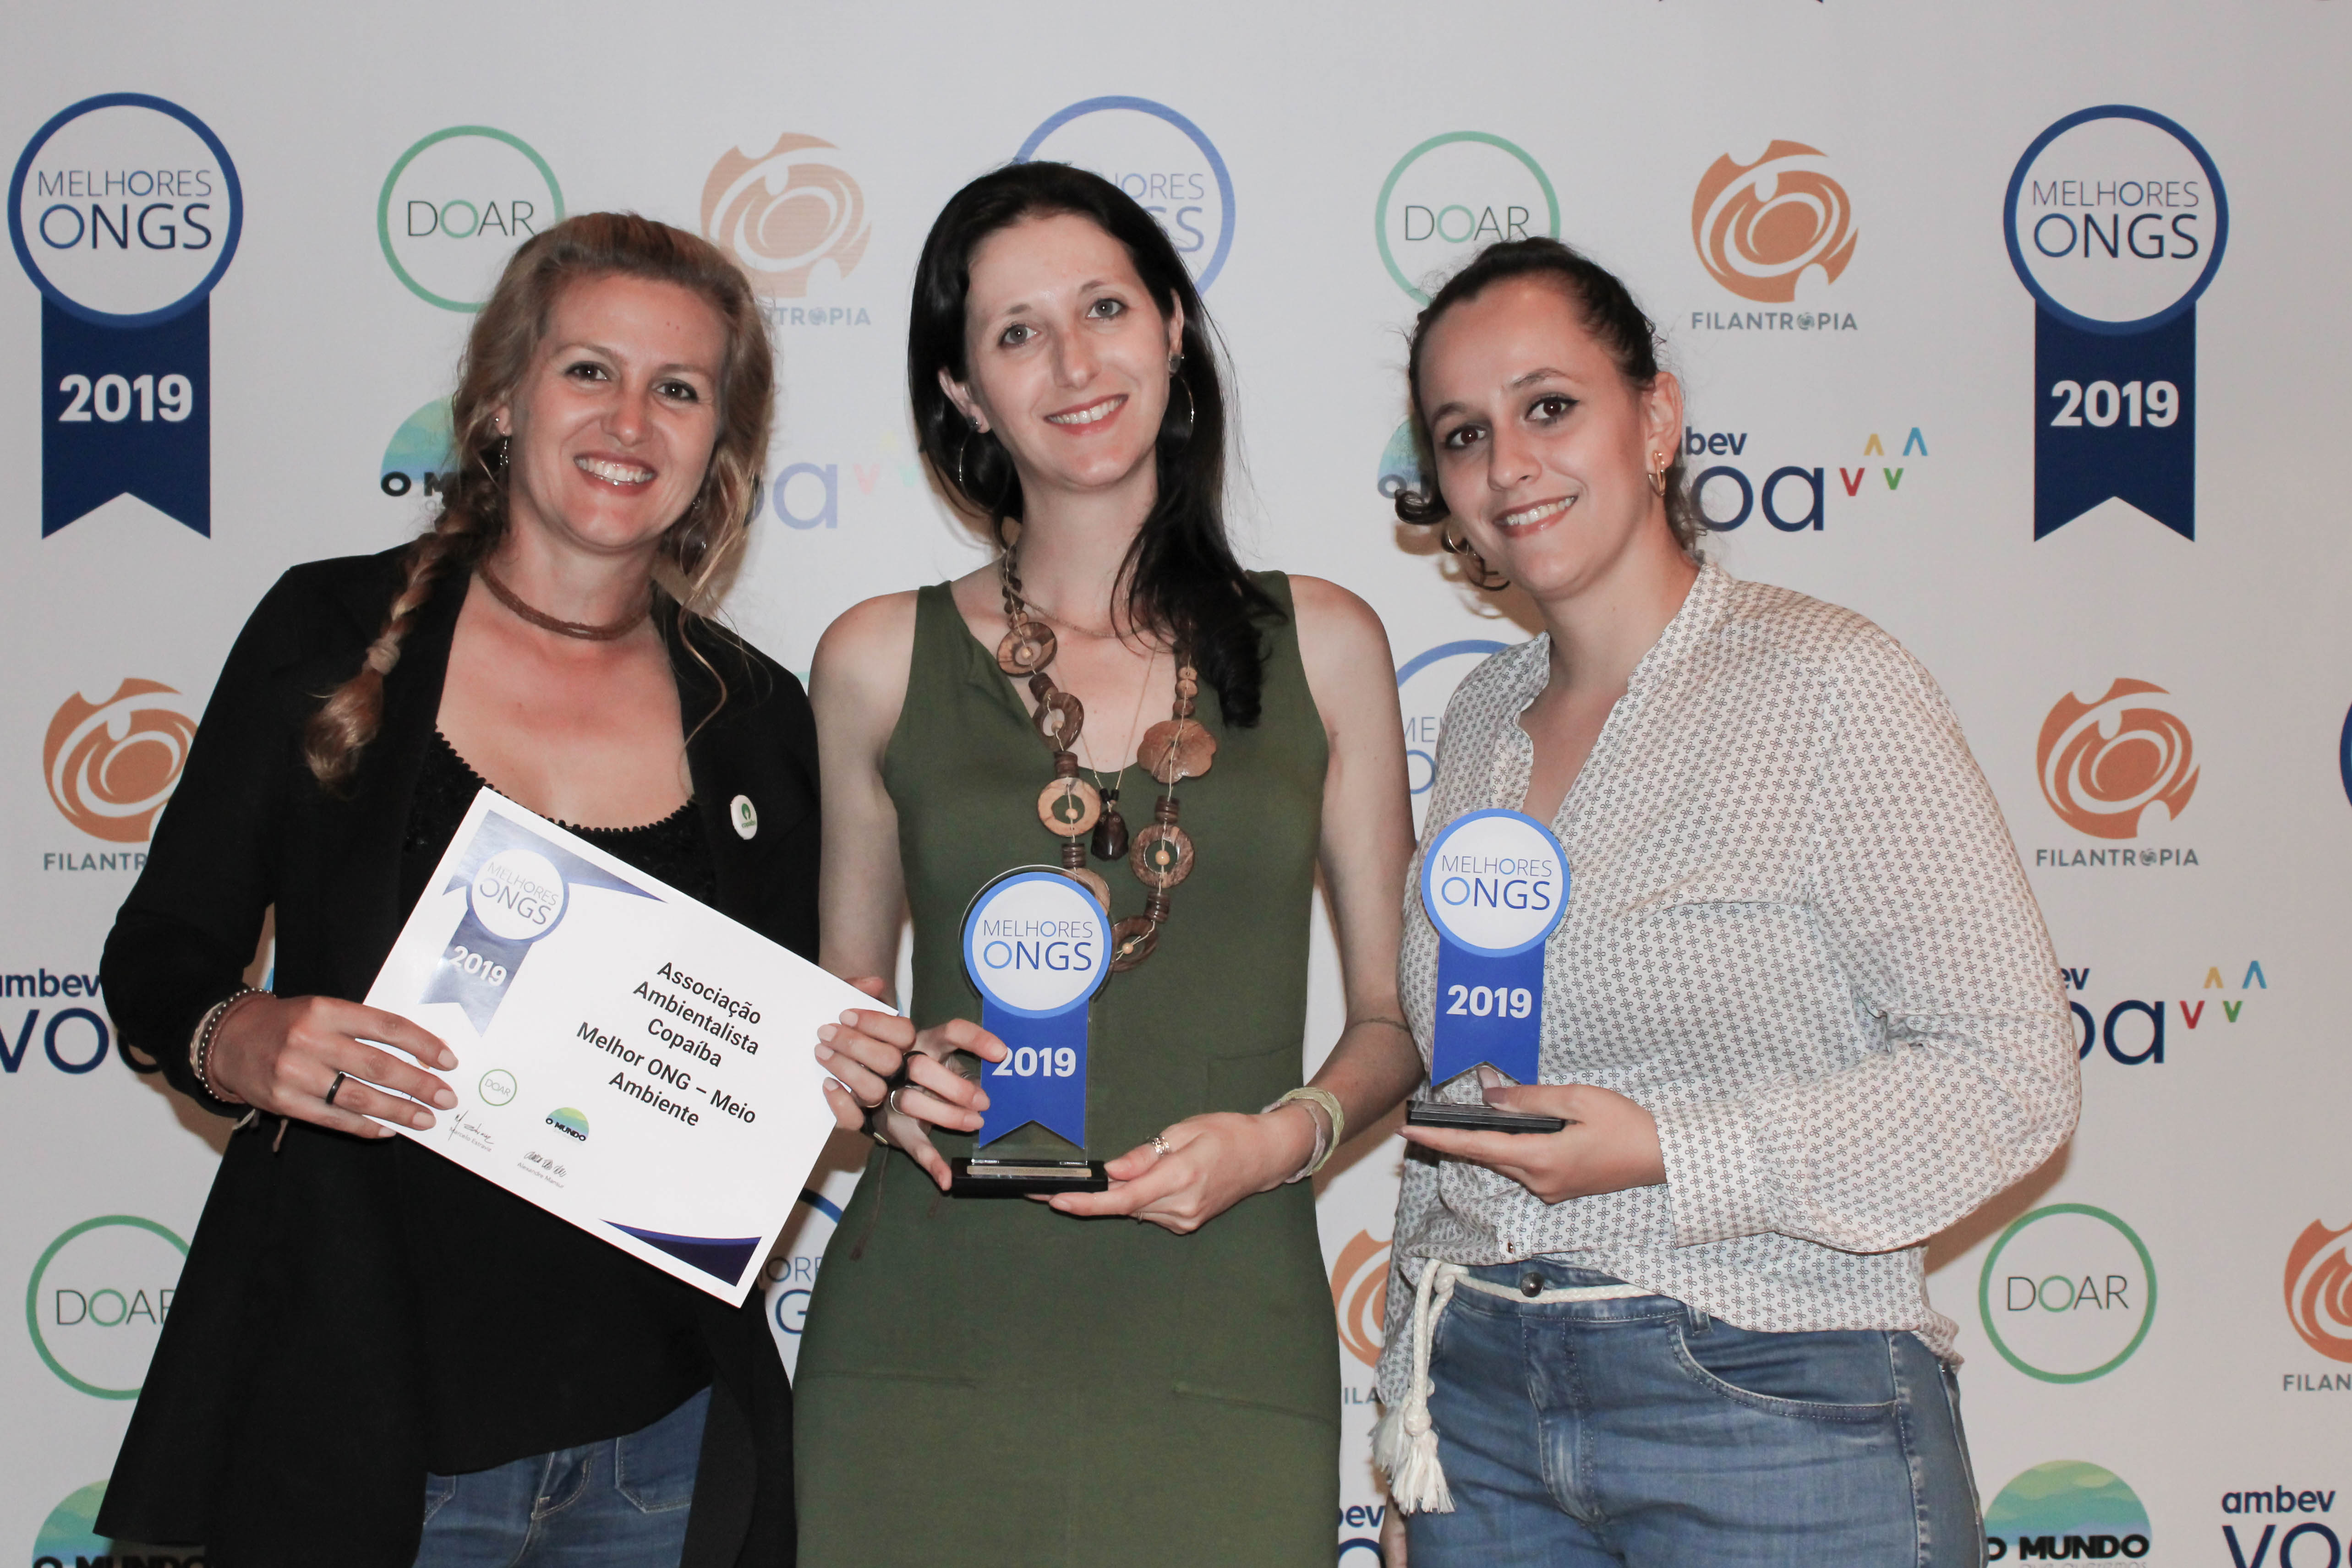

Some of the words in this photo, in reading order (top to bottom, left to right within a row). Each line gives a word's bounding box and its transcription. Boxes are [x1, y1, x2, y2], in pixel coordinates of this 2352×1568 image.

[38, 170, 212, 197] MELHORES
[1115, 173, 1204, 199] ORES
[2033, 181, 2199, 207] MELHORES
[39, 203, 212, 250] ONGS
[408, 200, 535, 238] DOAR
[1406, 204, 1530, 243] DOAR
[2034, 213, 2199, 259] ONGS
[774, 307, 871, 325] TROPIA
[1692, 311, 1858, 331] FILANTROPIA
[59, 374, 193, 422] 2019
[2050, 380, 2179, 427] 2019
[1685, 426, 1748, 455] bev
[1690, 466, 1824, 532] oa
[44, 853, 148, 871] FILANTR
[1442, 855, 1552, 877] MELHORES
[2036, 849, 2199, 867] FILANTROPIA
[487, 862, 558, 906] MELHORES
[1441, 876, 1551, 911] ONGS
[480, 878, 551, 925] ONGS
[983, 919, 1093, 938] MELHORES
[449, 945, 507, 986] 2019
[984, 940, 1092, 971] ONGS
[0, 968, 100, 997] mbev
[657, 962, 760, 1024] Associação
[633, 981, 759, 1054] Ambientalista
[1447, 985, 1532, 1018] 2019
[648, 1019, 721, 1067] Copaíba
[577, 1022, 645, 1066] Melhor
[648, 1059, 691, 1090] ONG
[710, 1089, 755, 1123] Meio
[991, 1047, 1077, 1077] 2019
[485, 1079, 511, 1096] DOAR
[609, 1072, 699, 1125] Ambiente
[554, 1121, 586, 1142] MUNDO
[2007, 1275, 2129, 1312] DOAR
[2222, 1485, 2336, 1513] ambev
[2019, 1534, 2150, 1560] MUNDO
